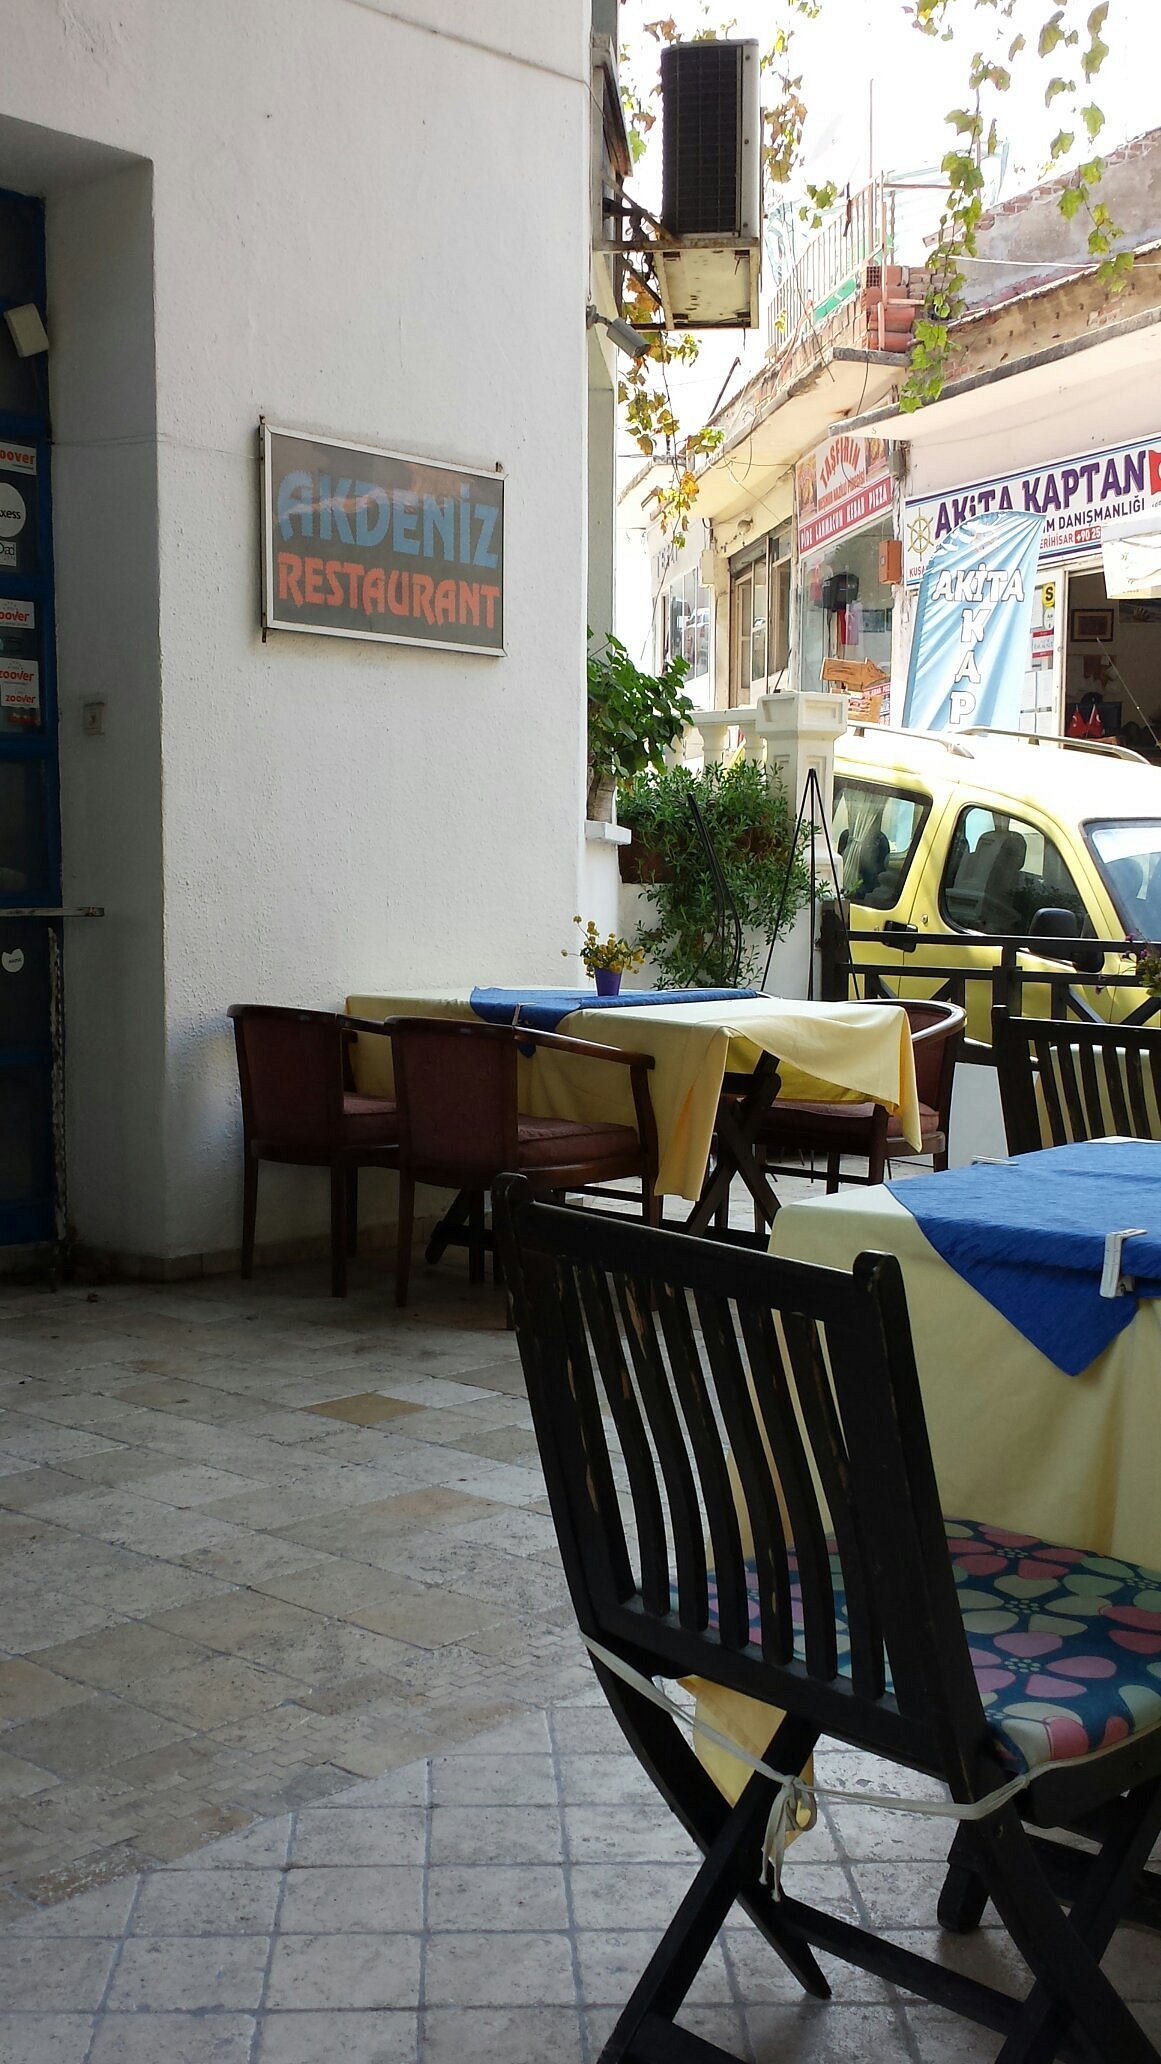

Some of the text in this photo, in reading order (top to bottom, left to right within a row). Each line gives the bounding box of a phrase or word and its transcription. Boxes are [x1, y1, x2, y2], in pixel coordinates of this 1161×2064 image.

[1021, 449, 1146, 514] KAPTAN
[0, 509, 21, 519] xess
[277, 470, 500, 569] AKDENİZ
[1058, 495, 1145, 530] DANIŞMANLIĞI
[277, 551, 501, 629] RESTAURANT
[5, 694, 36, 704] zoover
